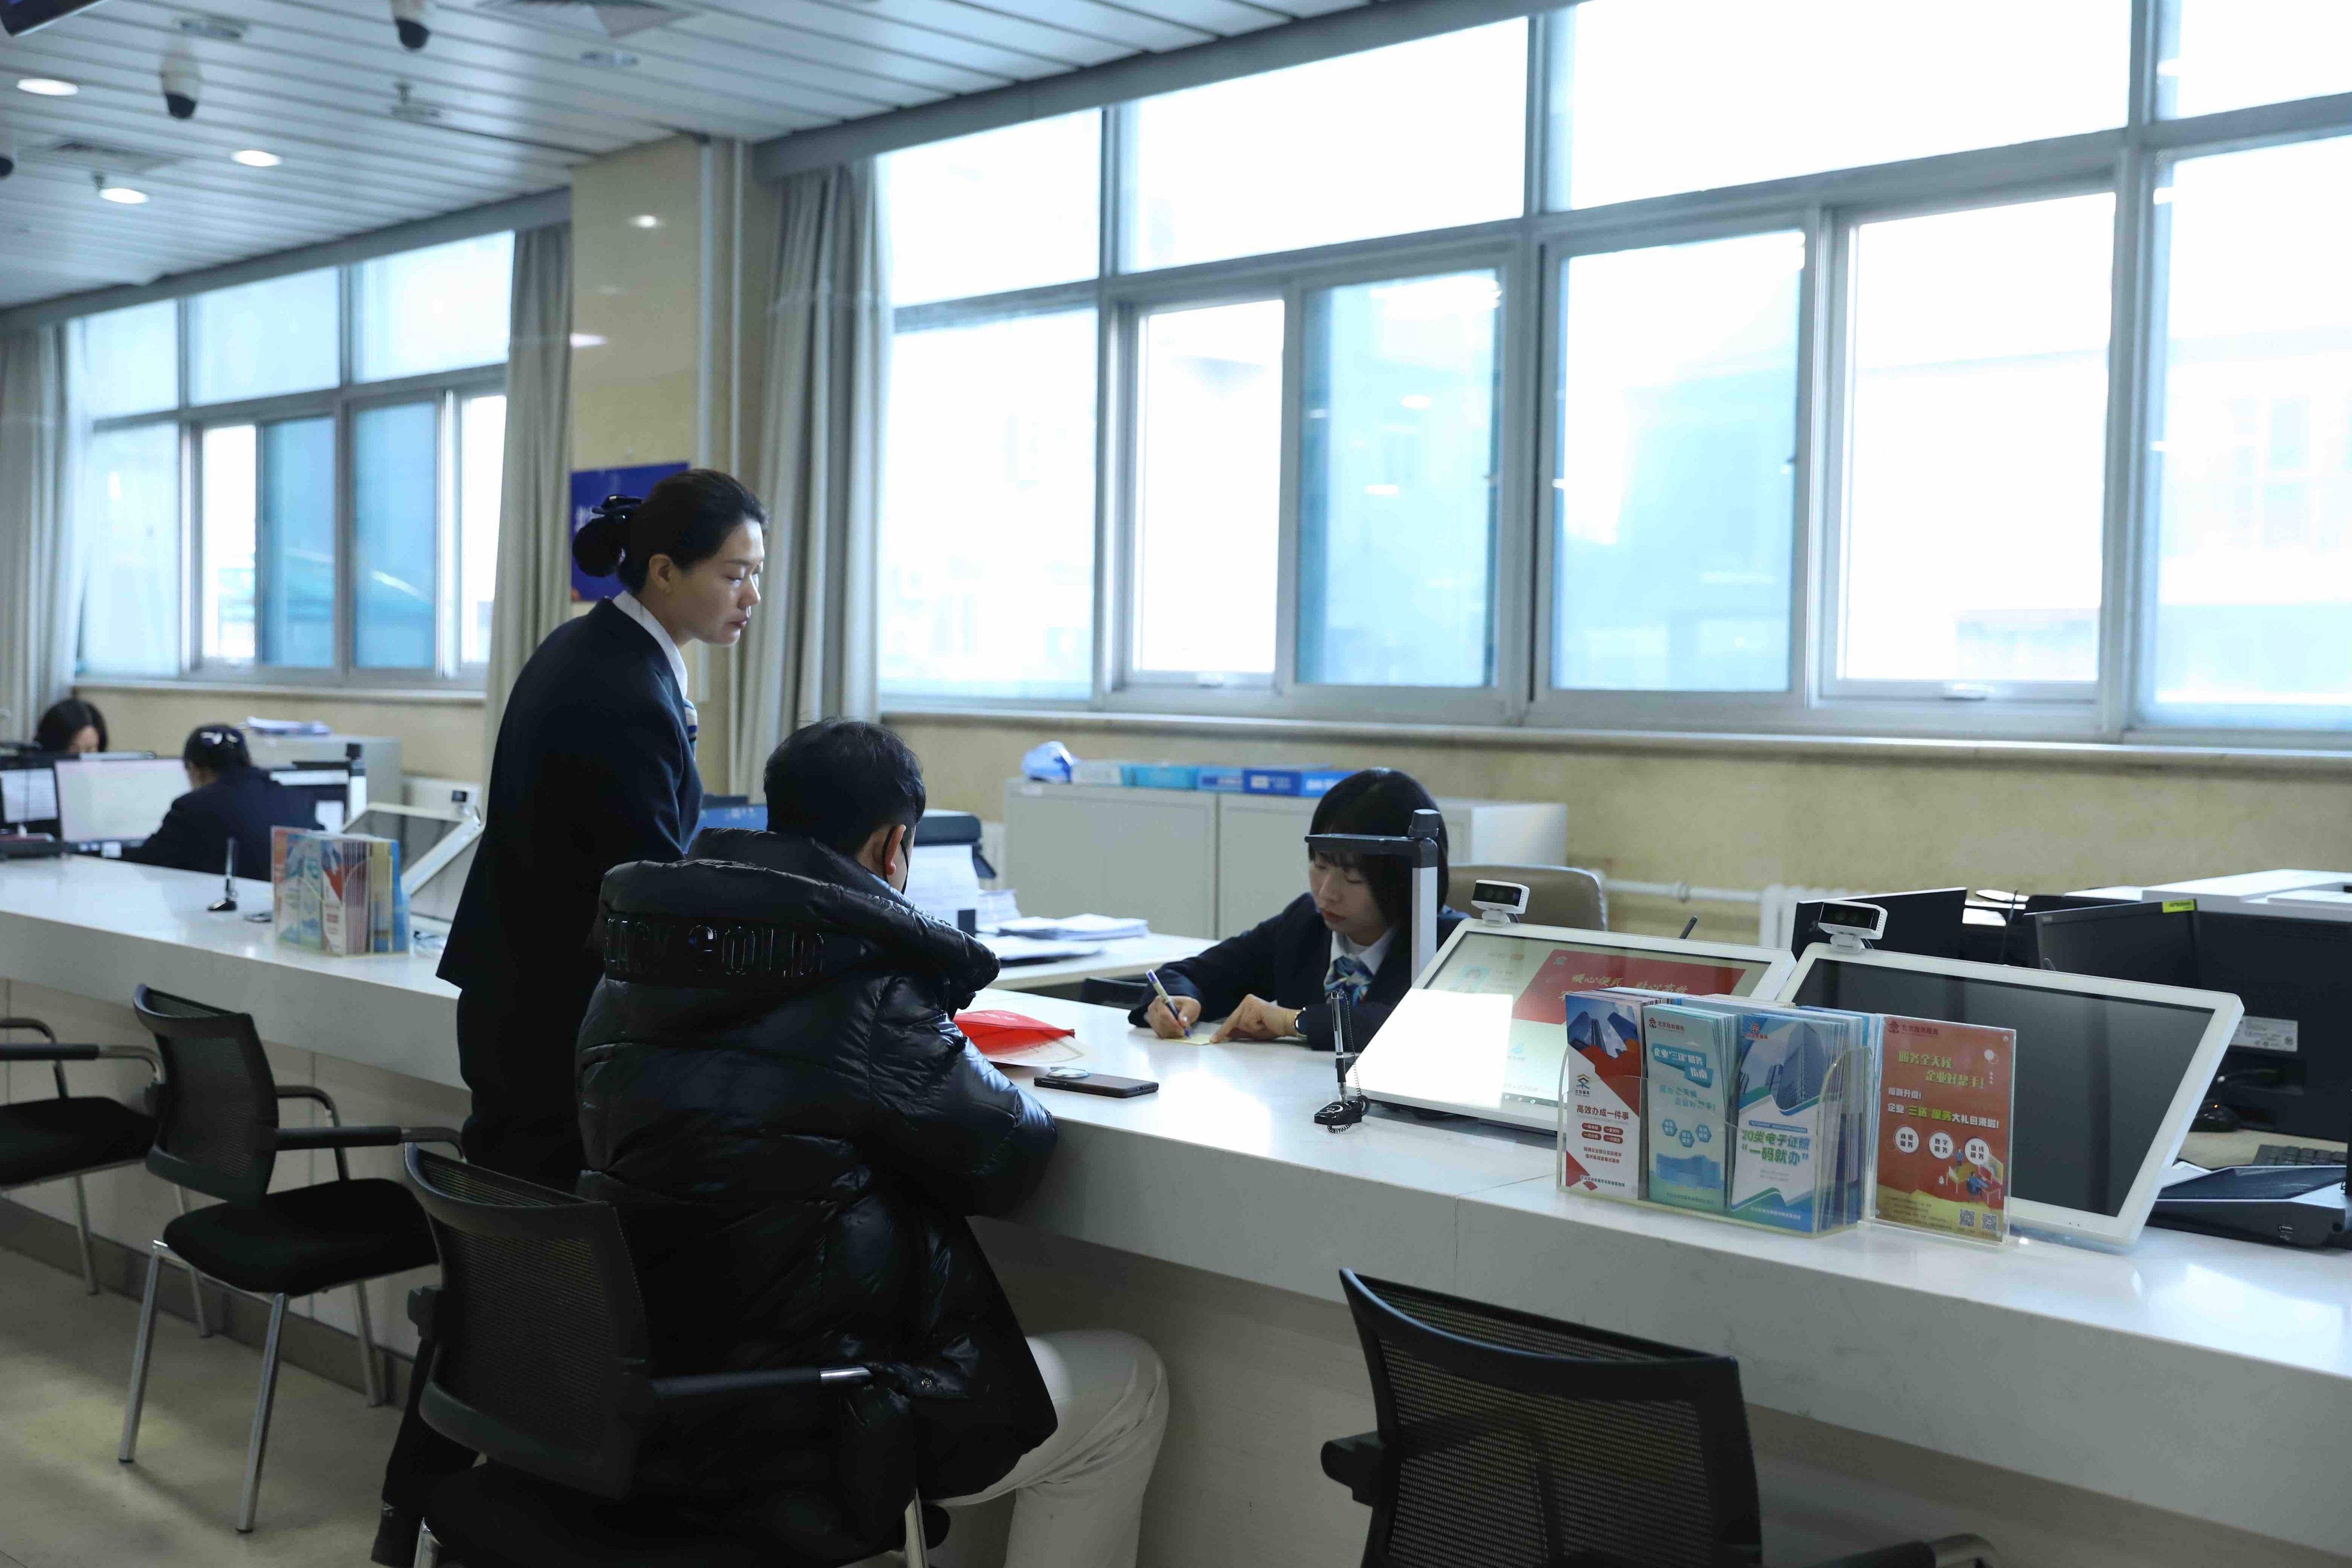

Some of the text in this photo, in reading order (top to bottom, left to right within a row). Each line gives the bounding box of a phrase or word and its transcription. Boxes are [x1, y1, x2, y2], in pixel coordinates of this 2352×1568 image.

[1898, 1050, 1953, 1069] 服务全天候
[1576, 1104, 1629, 1120] 高效办成一件事
[1742, 1129, 1810, 1150] 20类电子证照
